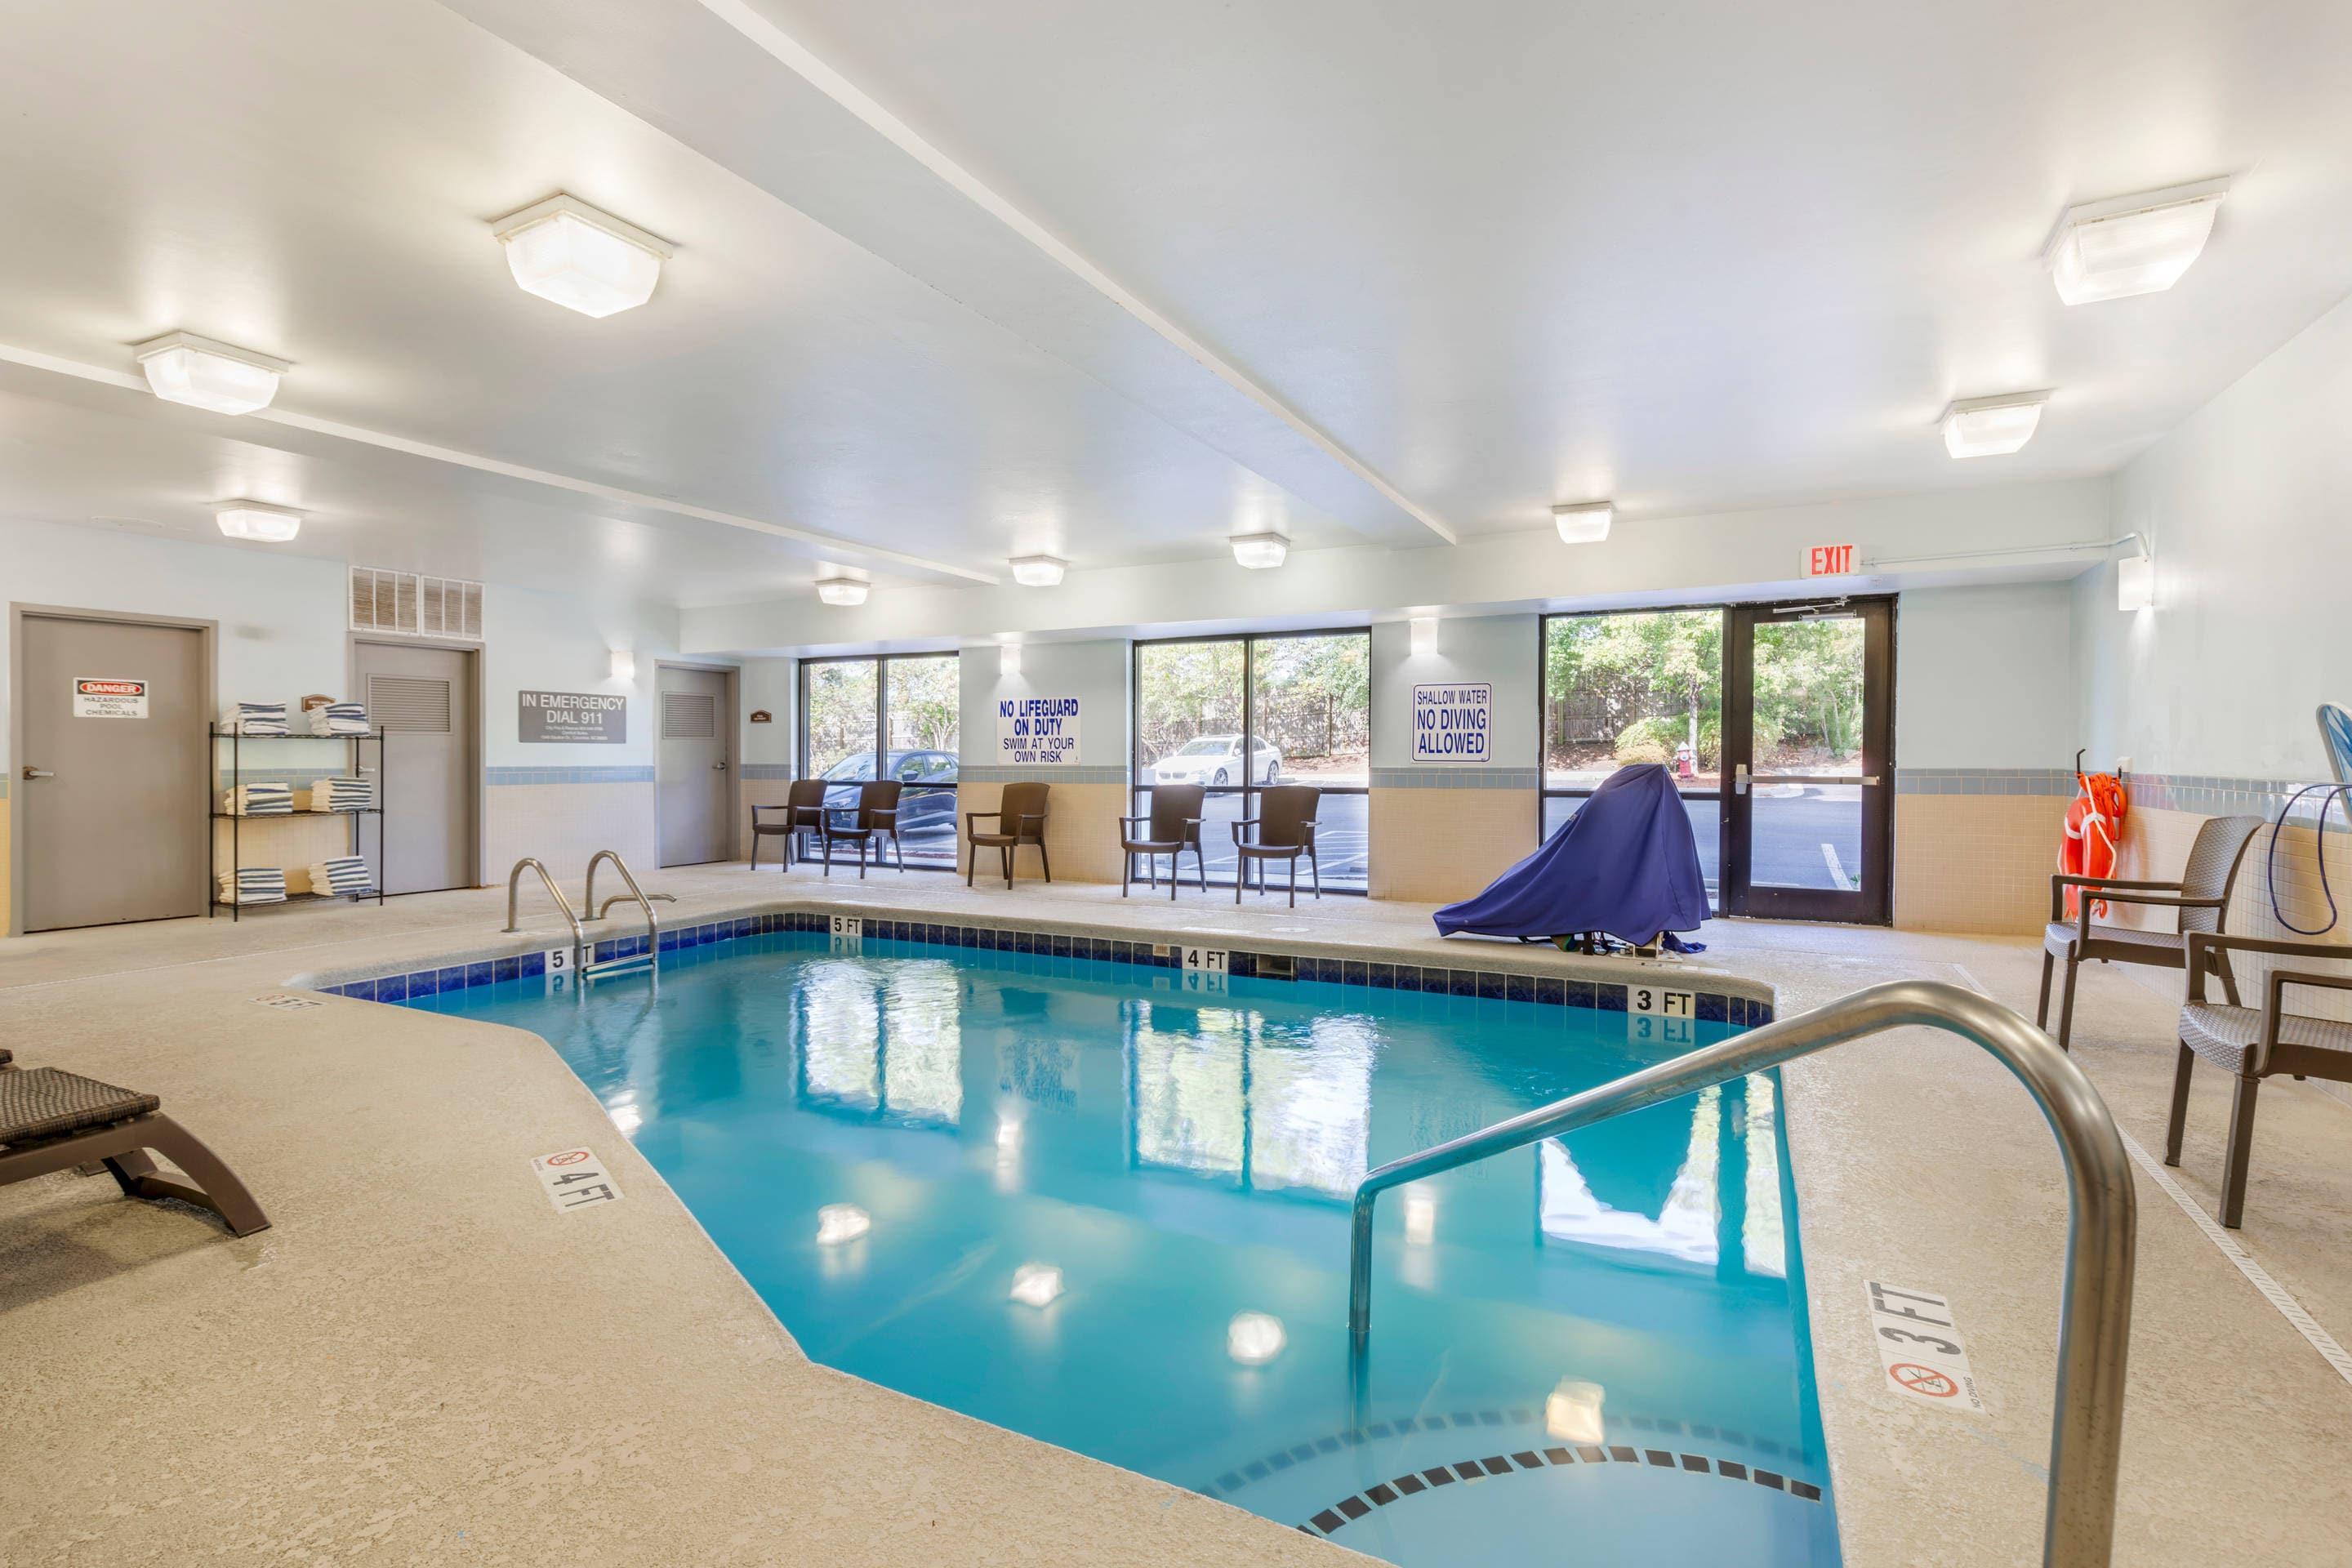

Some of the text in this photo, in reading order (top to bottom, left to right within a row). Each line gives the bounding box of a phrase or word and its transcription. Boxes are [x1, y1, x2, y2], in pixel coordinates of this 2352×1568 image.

[1811, 545, 1852, 575] EXIT
[87, 684, 136, 693] DANGER
[1418, 689, 1487, 705] SHALLOW WATER
[523, 693, 624, 710] IN EMERGENCY
[1000, 698, 1078, 717] NO LIFEGUARD
[546, 710, 602, 724] DIAL 911
[1418, 708, 1486, 729] NO DIVING
[1014, 718, 1062, 736] ON DUTY
[1004, 737, 1074, 750] SWIM AT YOUR
[1419, 733, 1485, 754] ALLOWED
[1014, 751, 1062, 763] OWN RISK
[835, 918, 860, 933] 5 FT
[553, 951, 564, 968] 5
[1188, 950, 1226, 969] 4 FT
[1637, 990, 1691, 1014] 3 FT
[553, 1173, 615, 1207] 4 FT
[1869, 1281, 1962, 1355] 3 FT
